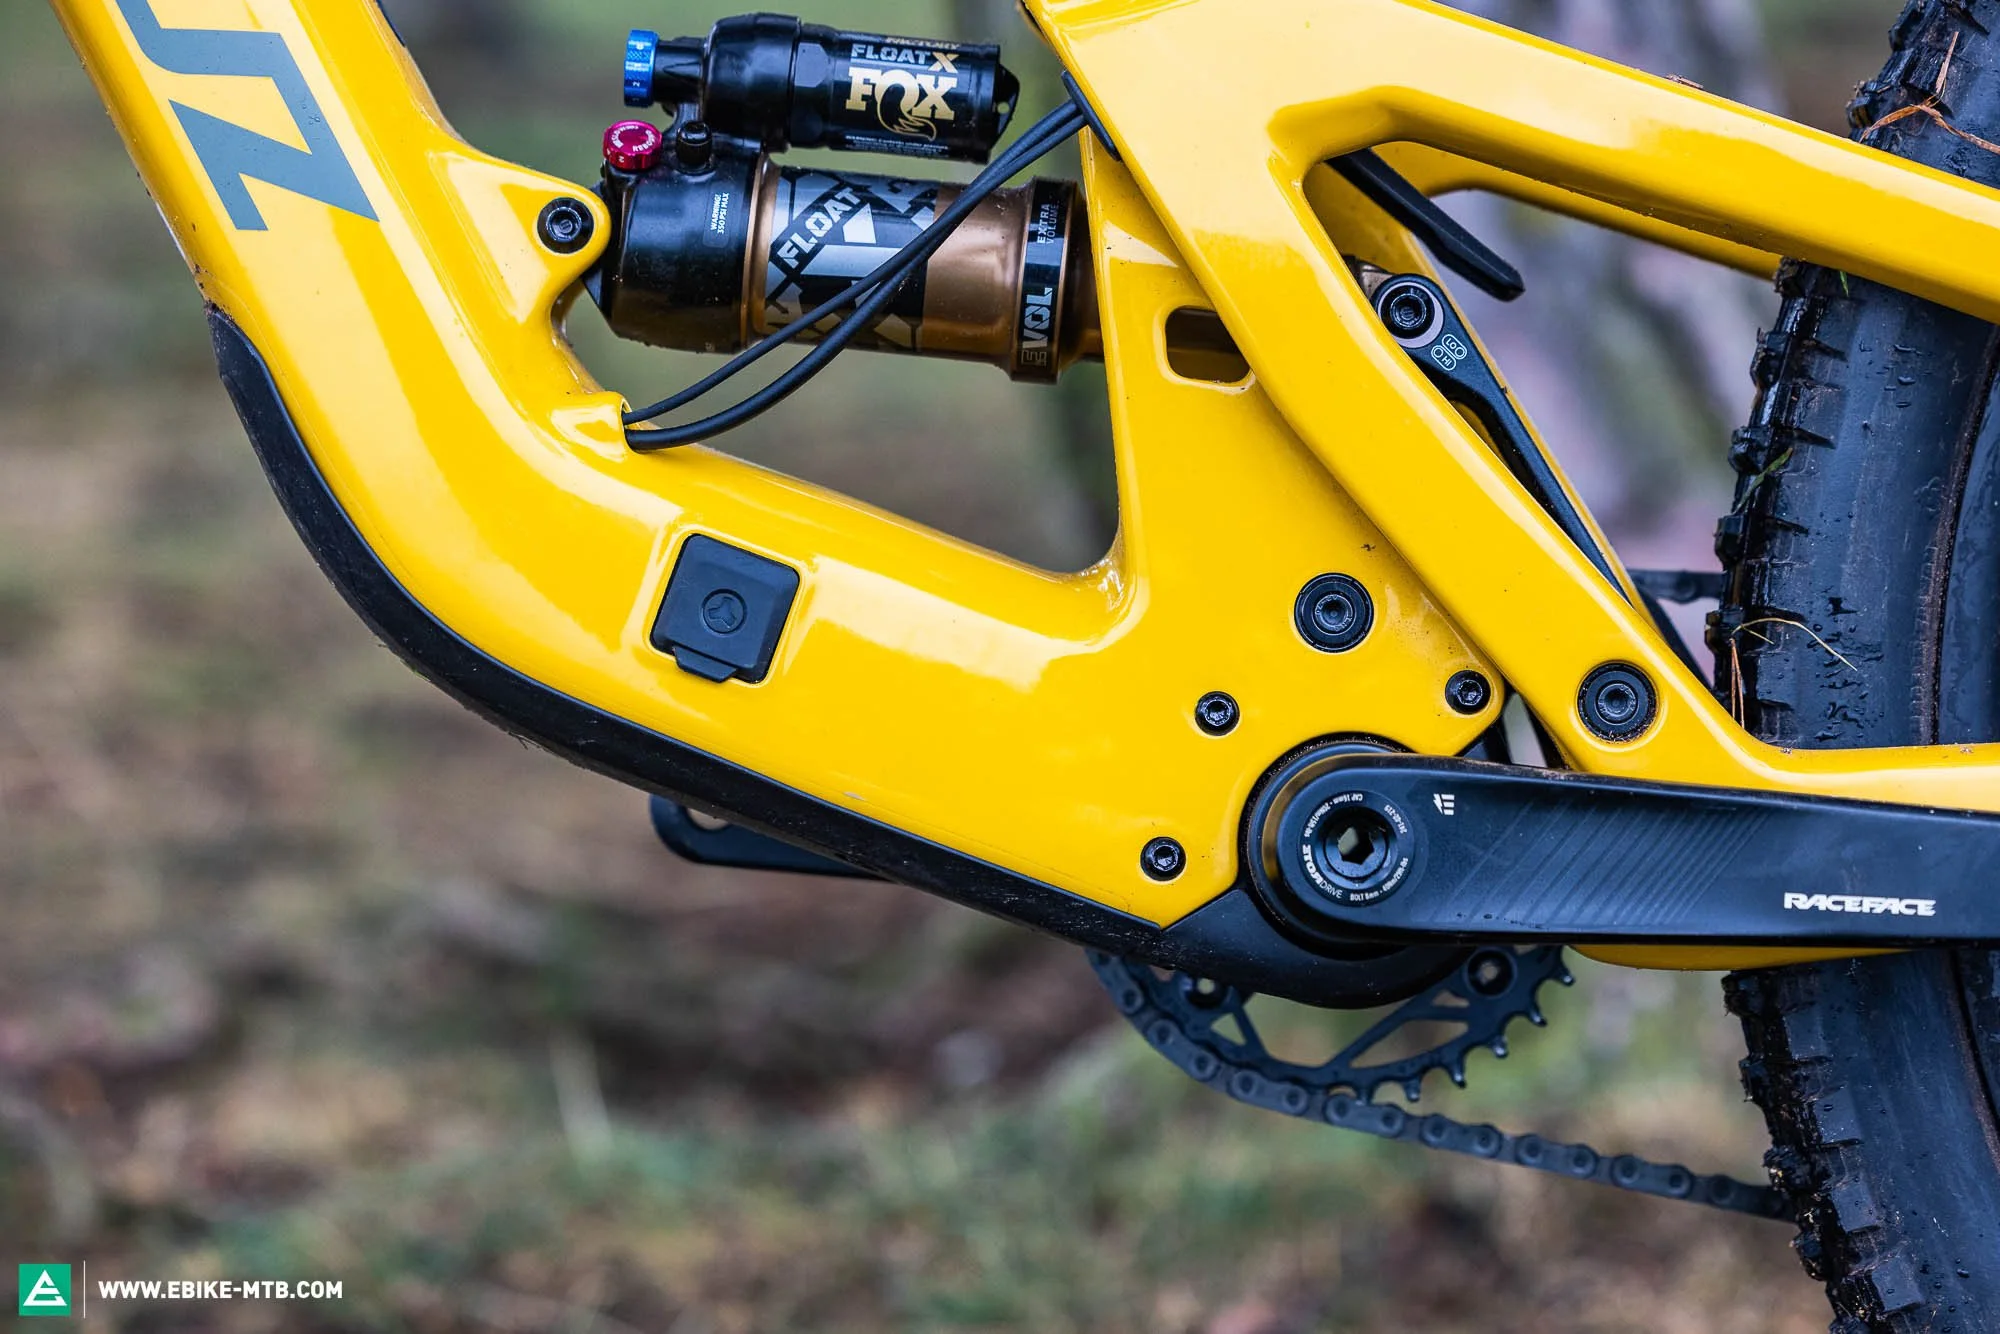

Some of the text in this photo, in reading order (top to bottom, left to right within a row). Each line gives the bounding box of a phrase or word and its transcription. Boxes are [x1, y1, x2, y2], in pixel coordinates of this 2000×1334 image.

[851, 44, 961, 73] FLOAT X
[845, 66, 959, 141] FOX
[719, 208, 727, 220] PSI
[720, 192, 730, 208] MAX
[777, 187, 861, 269] FLOAT
[1036, 203, 1049, 244] EXTRA
[1021, 287, 1052, 368] EVOL
